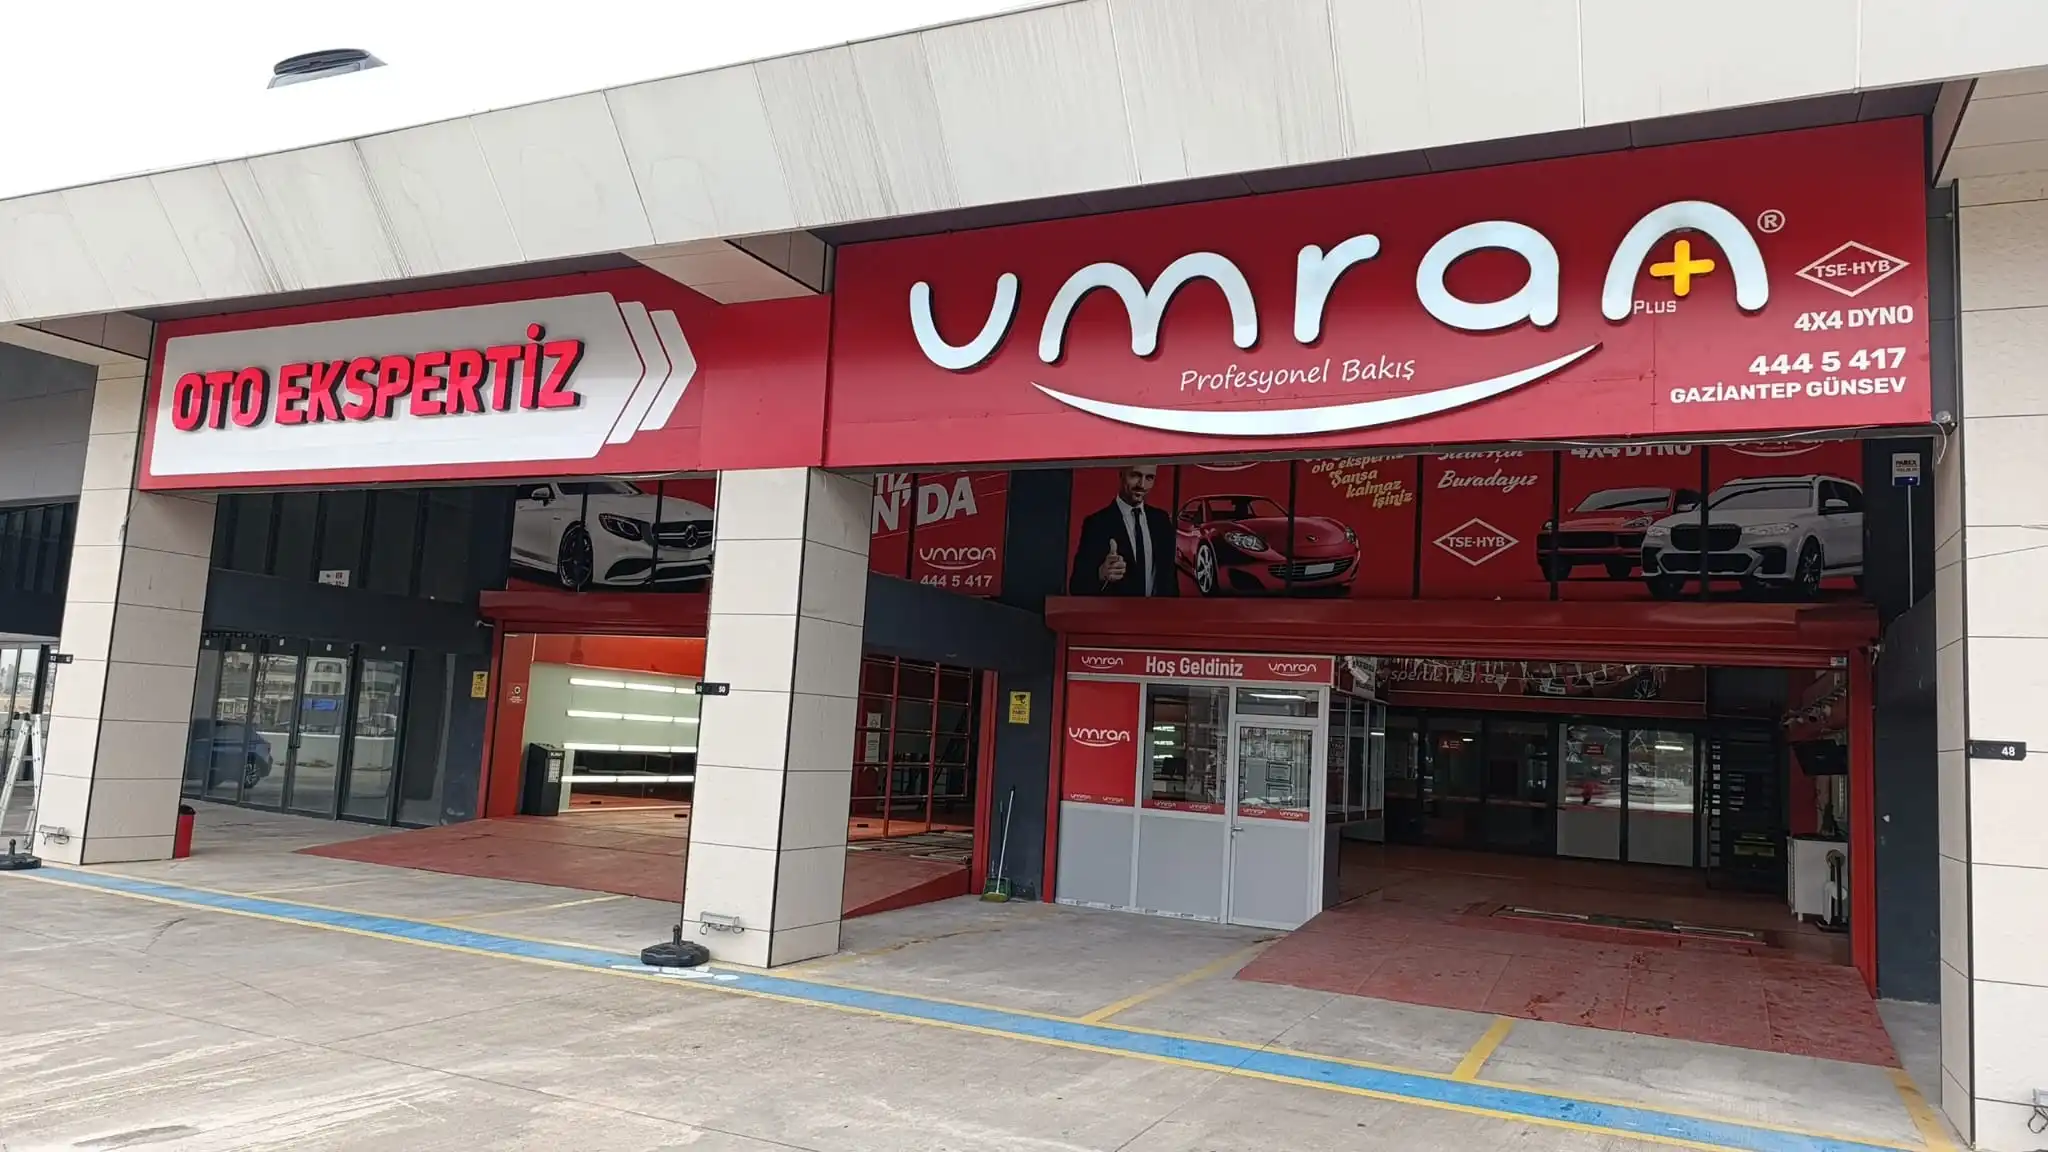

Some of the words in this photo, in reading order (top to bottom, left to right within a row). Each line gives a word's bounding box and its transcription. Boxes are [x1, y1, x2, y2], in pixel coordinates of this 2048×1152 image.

[1814, 260, 1891, 278] TSE-HYB
[1794, 309, 1843, 332] 4X4
[1848, 304, 1914, 328] DYNO
[1749, 352, 1814, 376] 444
[1821, 350, 1842, 373] 5
[1848, 346, 1907, 371] 417
[171, 366, 268, 432] OTO
[275, 322, 585, 427] EKSPERTİZ
[1180, 357, 1331, 394] Profesyonel
[1341, 354, 1416, 382] Bakış
[1669, 381, 1802, 404] GAZİANTEP
[1806, 376, 1907, 398] GÜNSEV
[1437, 467, 1539, 494] Buradayız
[1447, 536, 1506, 549] TSE-HYB
[919, 547, 997, 562] umran
[920, 575, 947, 588] 444
[951, 575, 961, 588] 5
[965, 575, 993, 588] 417
[1081, 655, 1124, 667] umran
[1145, 655, 1176, 678] Hoş
[1180, 657, 1243, 678] Geldiniz
[1268, 662, 1317, 674] umran
[1068, 726, 1131, 744] umran
[2001, 746, 2016, 757] 48
